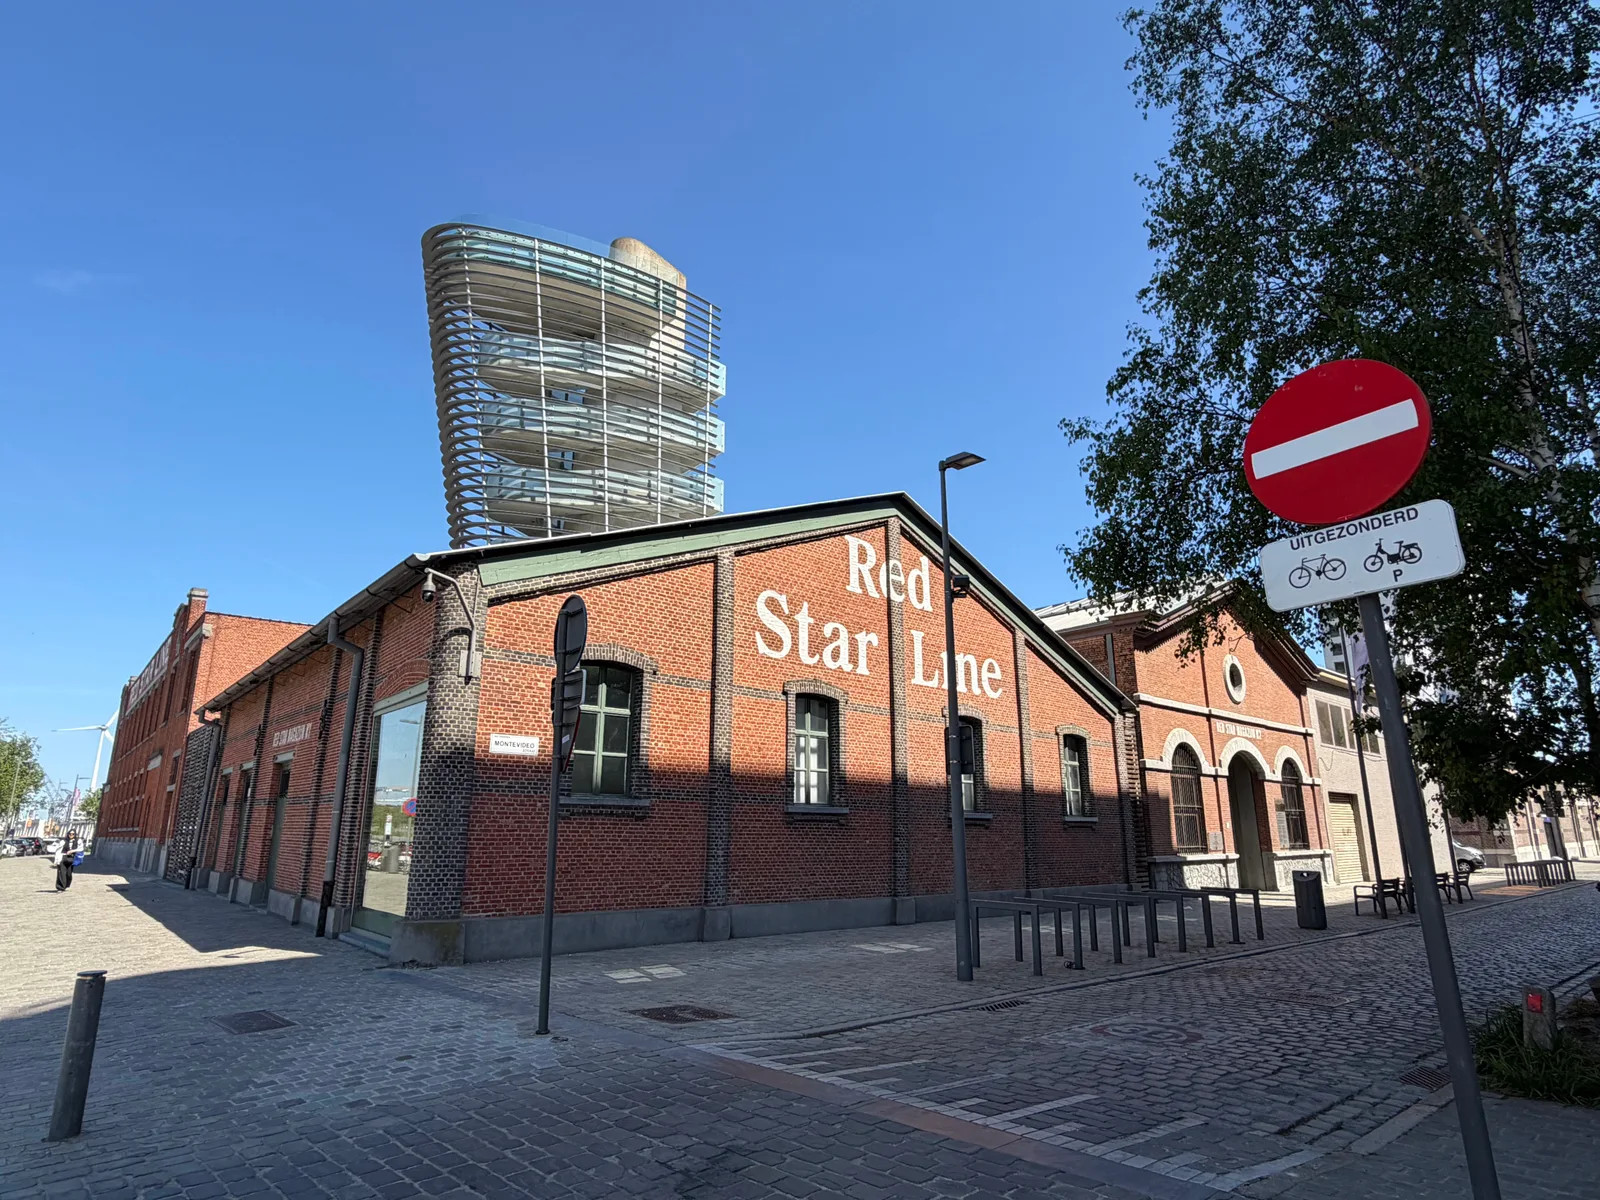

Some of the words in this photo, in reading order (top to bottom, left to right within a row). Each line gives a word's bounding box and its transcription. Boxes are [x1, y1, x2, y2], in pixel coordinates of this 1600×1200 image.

[1290, 507, 1419, 551] UITGEZONDERD
[845, 535, 933, 612] Red
[1393, 569, 1403, 582] P
[755, 590, 878, 675] Star
[494, 741, 535, 749] MONTEVIDEO
